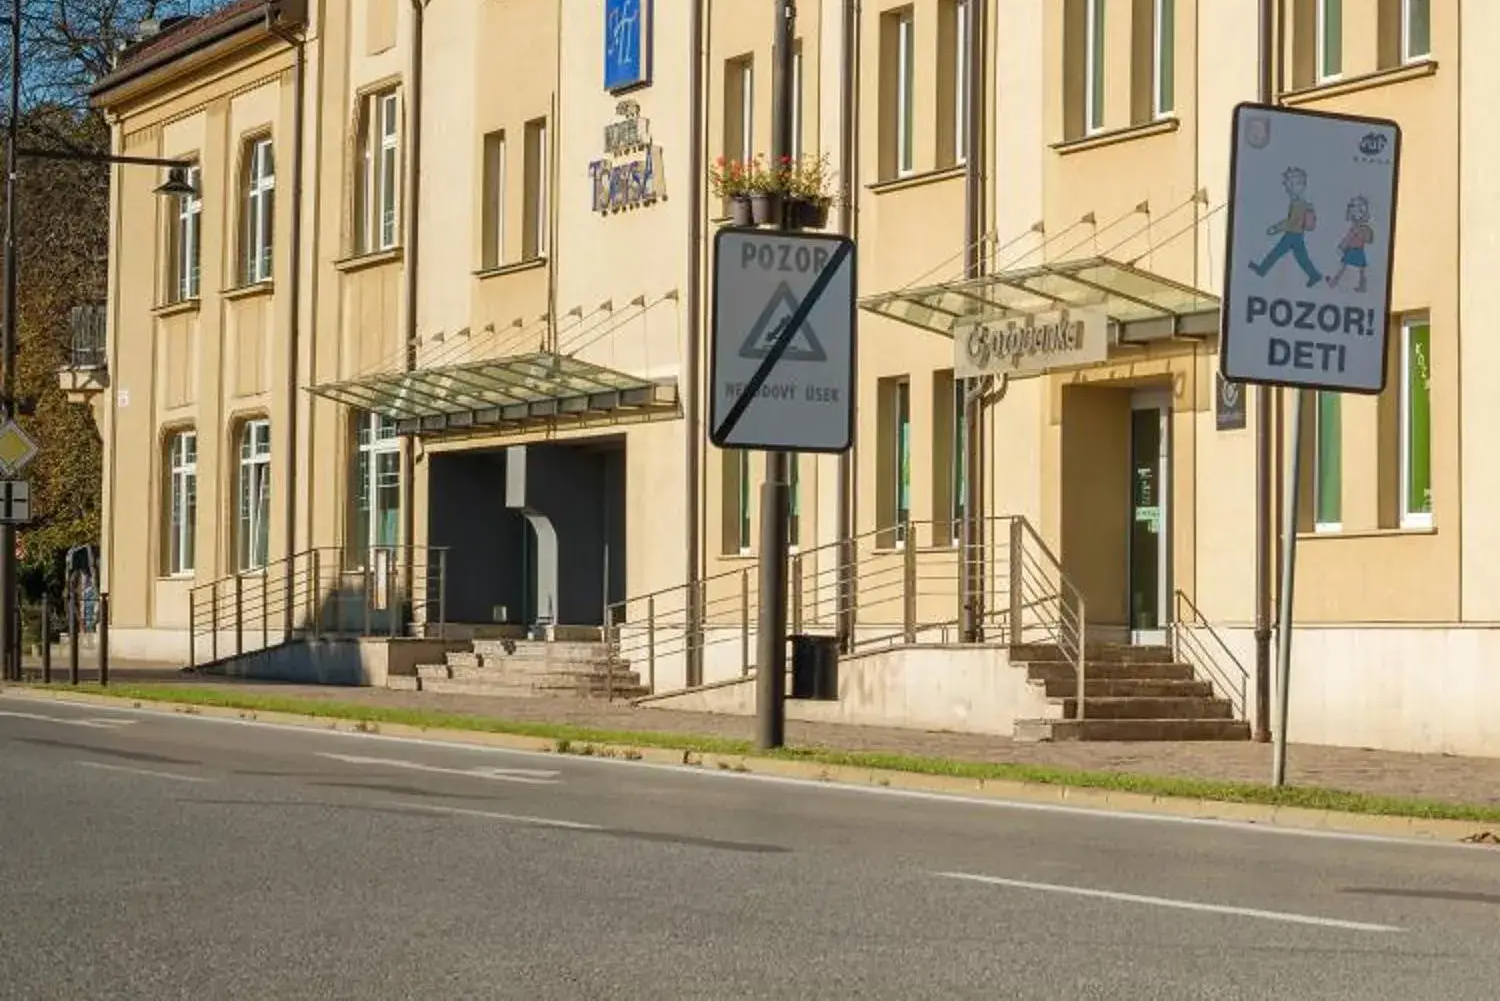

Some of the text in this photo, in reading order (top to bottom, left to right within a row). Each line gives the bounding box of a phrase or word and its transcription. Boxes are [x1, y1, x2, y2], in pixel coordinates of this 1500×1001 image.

[741, 241, 829, 274] POZOR
[1246, 295, 1375, 335] POZOR!
[1267, 338, 1346, 373] DETI
